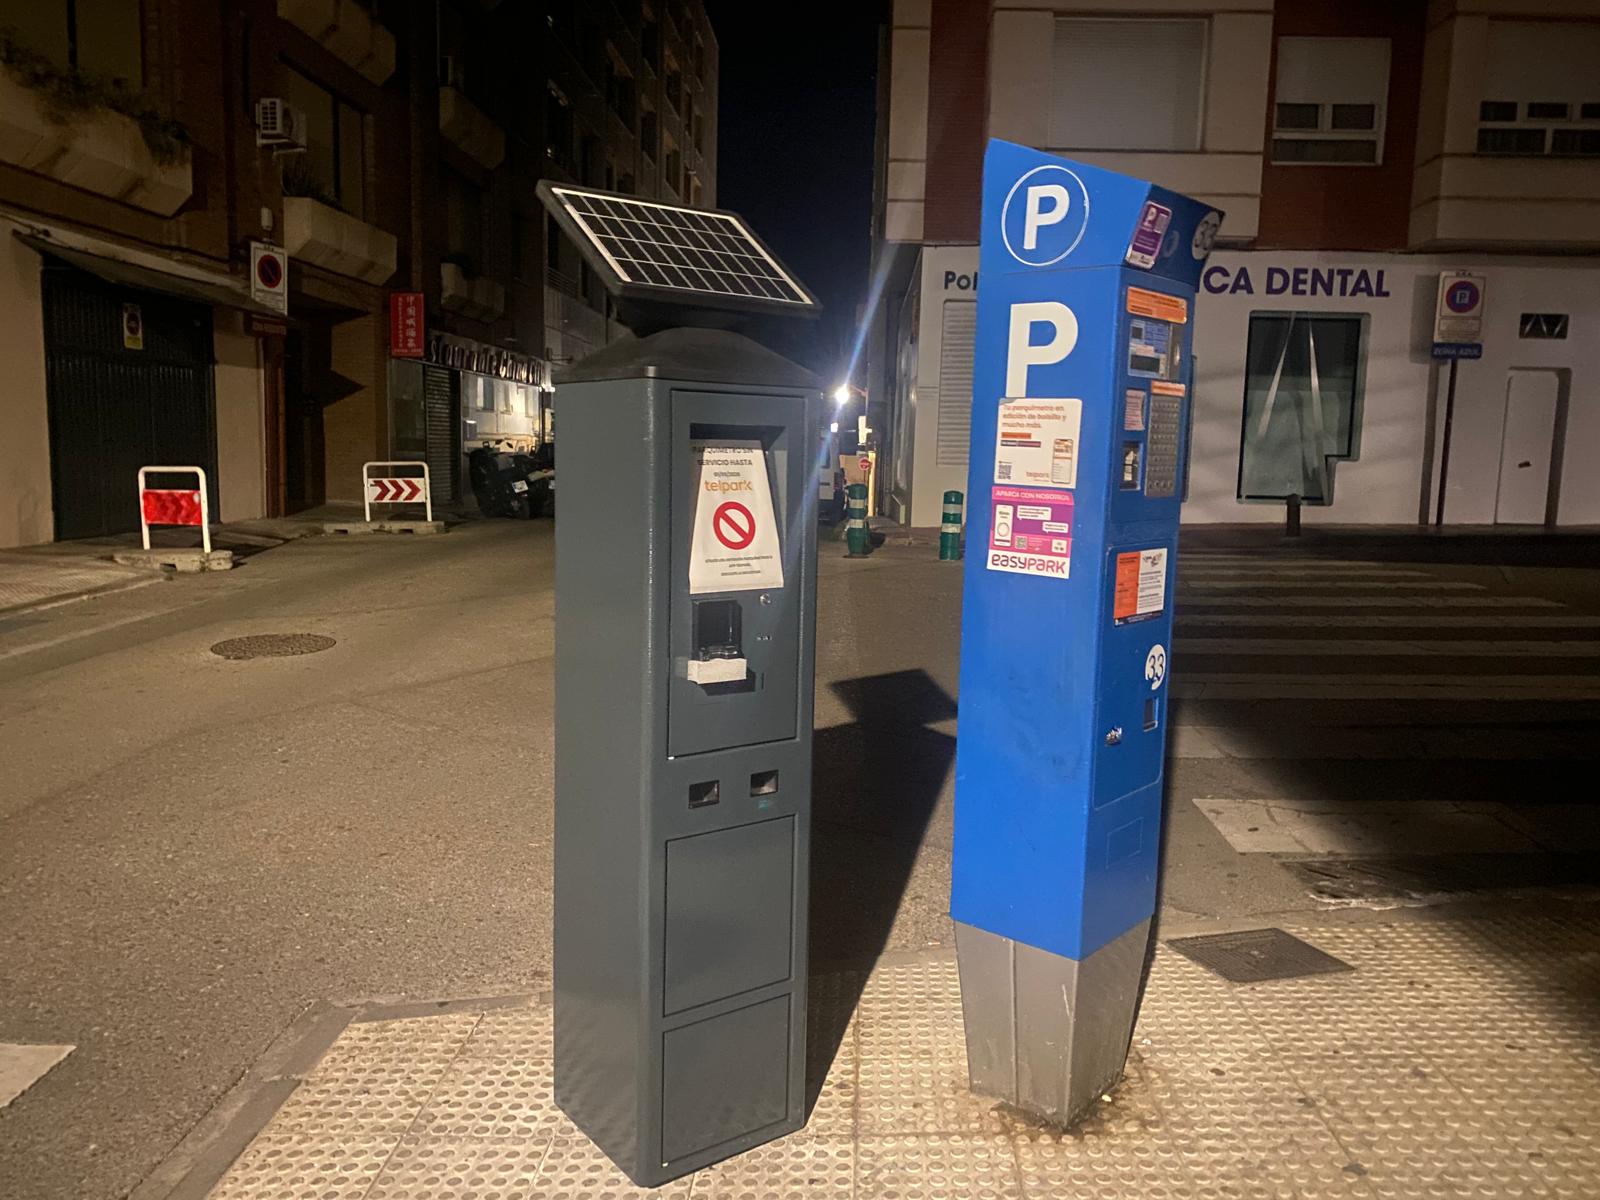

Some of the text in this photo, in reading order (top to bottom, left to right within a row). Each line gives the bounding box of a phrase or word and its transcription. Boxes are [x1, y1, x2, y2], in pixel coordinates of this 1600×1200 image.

[1024, 184, 1070, 249] P
[944, 271, 977, 290] Pol
[1197, 265, 1390, 297] CA DENTAL
[1005, 302, 1078, 398] P
[1433, 347, 1456, 356] ZONA
[704, 480, 753, 494] telpark
[1147, 654, 1164, 681] 33
